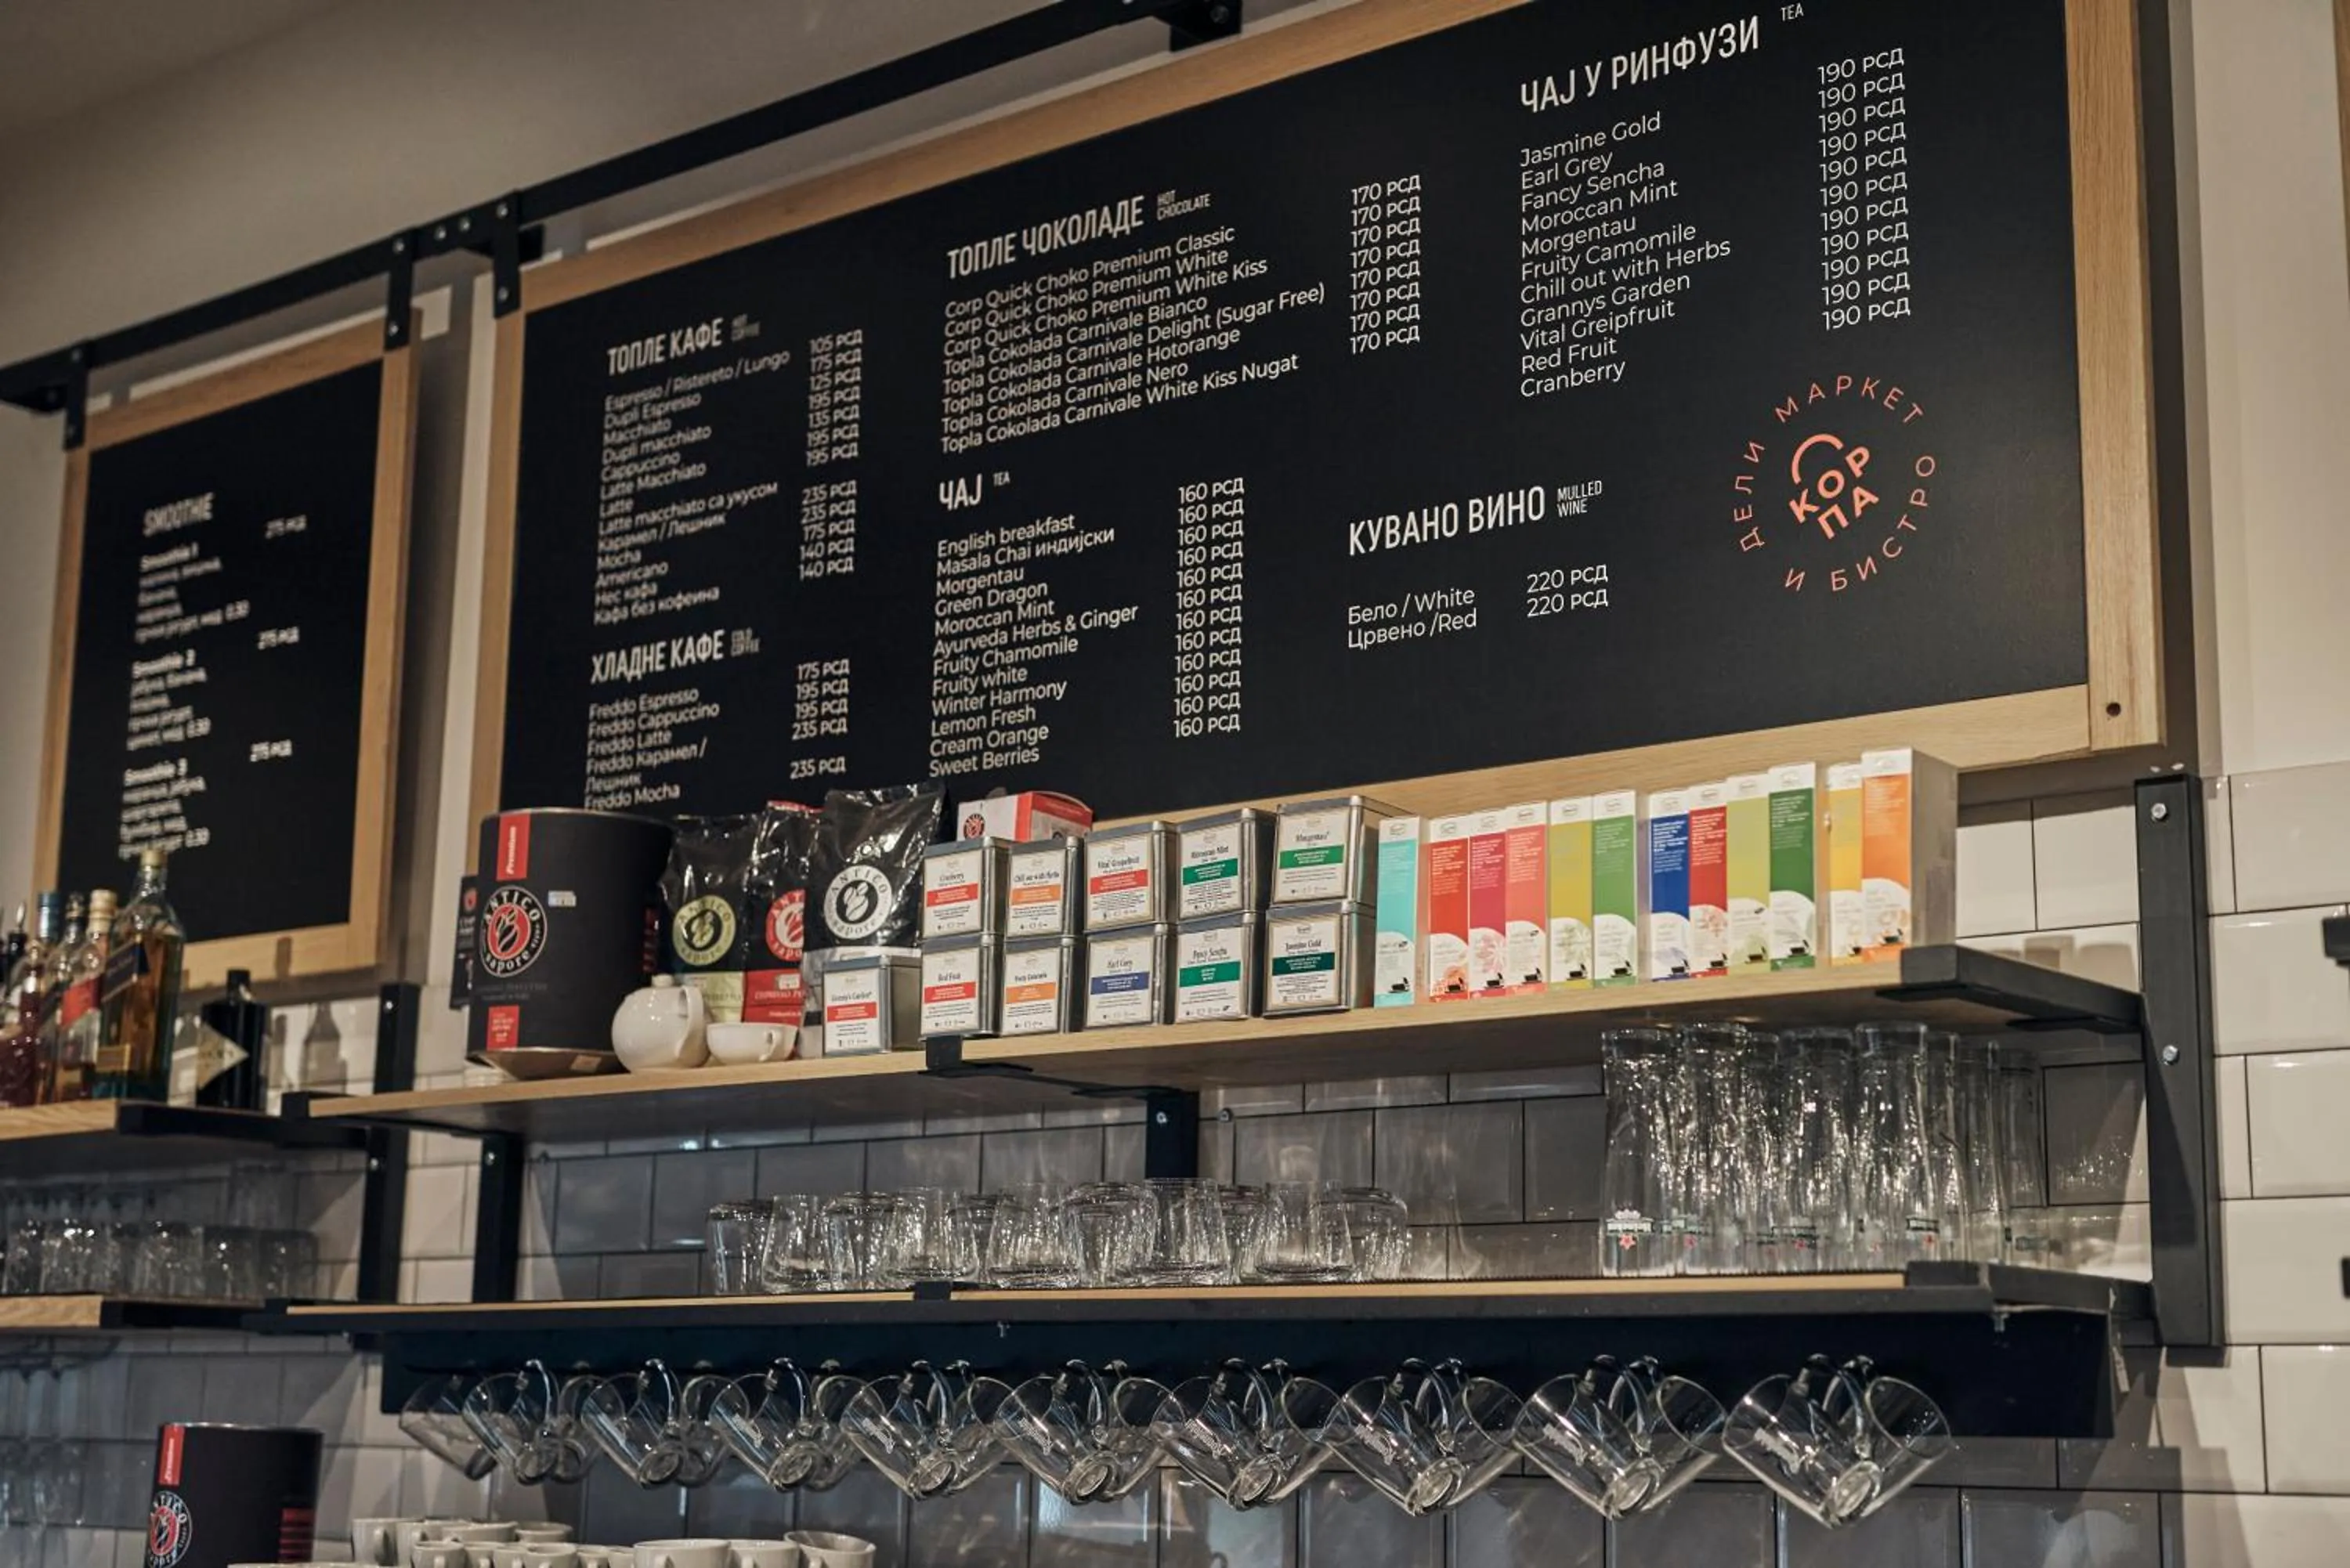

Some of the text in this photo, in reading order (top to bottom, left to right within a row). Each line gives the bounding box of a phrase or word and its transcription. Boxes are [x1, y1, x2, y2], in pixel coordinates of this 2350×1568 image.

[1781, 3, 1803, 21] TEA
[1521, 16, 1758, 113] ЧАЈ У РИНФУЗИ
[1817, 49, 1904, 85] 190 РСД
[1520, 111, 1660, 167] Jasmine Gold
[1352, 175, 1421, 205] 170 РСД
[1522, 152, 1612, 190] Earl Grey
[1522, 162, 1664, 212] Fancy Sencha
[1820, 172, 1907, 206] 190 РСД
[1157, 195, 1209, 221] CHOCOLATE
[1522, 180, 1678, 235] Moroccan Mint
[948, 195, 1144, 279] ТОПЛЕ ЧОКОЛАДЕ
[1522, 216, 1636, 258] Morgentau
[1522, 225, 1695, 281] Fruity Camomile
[945, 228, 1235, 318] Corp Quick Choko Premium Classic
[1521, 240, 1730, 303] Chill out with Herbs
[945, 259, 1267, 356] Corp Quick Choko Premium White Kiss
[1521, 275, 1690, 327] Grannys Garden
[1822, 297, 1911, 331] 190 РСД
[943, 284, 1324, 394] Topla Cokolada Carnivale Delight (Sugar Free)
[944, 297, 1207, 375] Topla Cokolada Carnivale Bianco
[1350, 325, 1419, 354] 170 РСД
[1520, 300, 1675, 350] Vital Greipfruit
[608, 334, 666, 374] ТОПЛЕ
[671, 318, 722, 358] КАФЕ
[1523, 338, 1617, 374] Red Fruit
[942, 329, 1241, 414] Topla Cokolada Carnivale Hotorange
[1521, 361, 1625, 397] Cranberry
[942, 354, 1299, 453] Topla Cokolada Carnivale White Kiss Nugat
[993, 471, 1010, 486] TEA
[1734, 374, 1924, 551] ДЕЛИ МАРКЕТ
[940, 474, 982, 510] ЧАЈ
[1178, 477, 1244, 504] 160 РСД
[1557, 480, 1602, 501] MULLED
[1557, 499, 1587, 517] WINE
[938, 515, 1075, 558] English breakfast
[1350, 486, 1545, 555] КУВАНО ВИНО
[1784, 456, 1936, 591] И БИСТРО
[937, 528, 1114, 576] Masala Chai индијски
[937, 567, 1024, 597] Morgentau
[1528, 564, 1608, 593] 220 РСД
[935, 583, 1047, 616] Green Dragon
[935, 600, 1054, 636] Moroccan Mint
[1349, 603, 1397, 625] Бело
[1415, 588, 1474, 612] White
[934, 629, 1007, 659] Ayurveda
[1013, 620, 1061, 641] Herbs
[1080, 605, 1138, 629] Ginger
[1349, 608, 1476, 650] Црвено /Red
[591, 641, 666, 683] ХЛАДНЕ
[671, 629, 725, 668] КАФЕ
[934, 635, 1078, 677] Fruity Chamomile
[932, 681, 1067, 716] Winter Harmony
[933, 667, 1028, 696] Fruity white
[792, 717, 848, 740] 235 РСД
[931, 704, 1036, 737] Lemon Fresh
[1173, 714, 1241, 738] 160 РСД
[931, 725, 1049, 757] Cream Orange
[929, 746, 1039, 777] Sweet Berries
